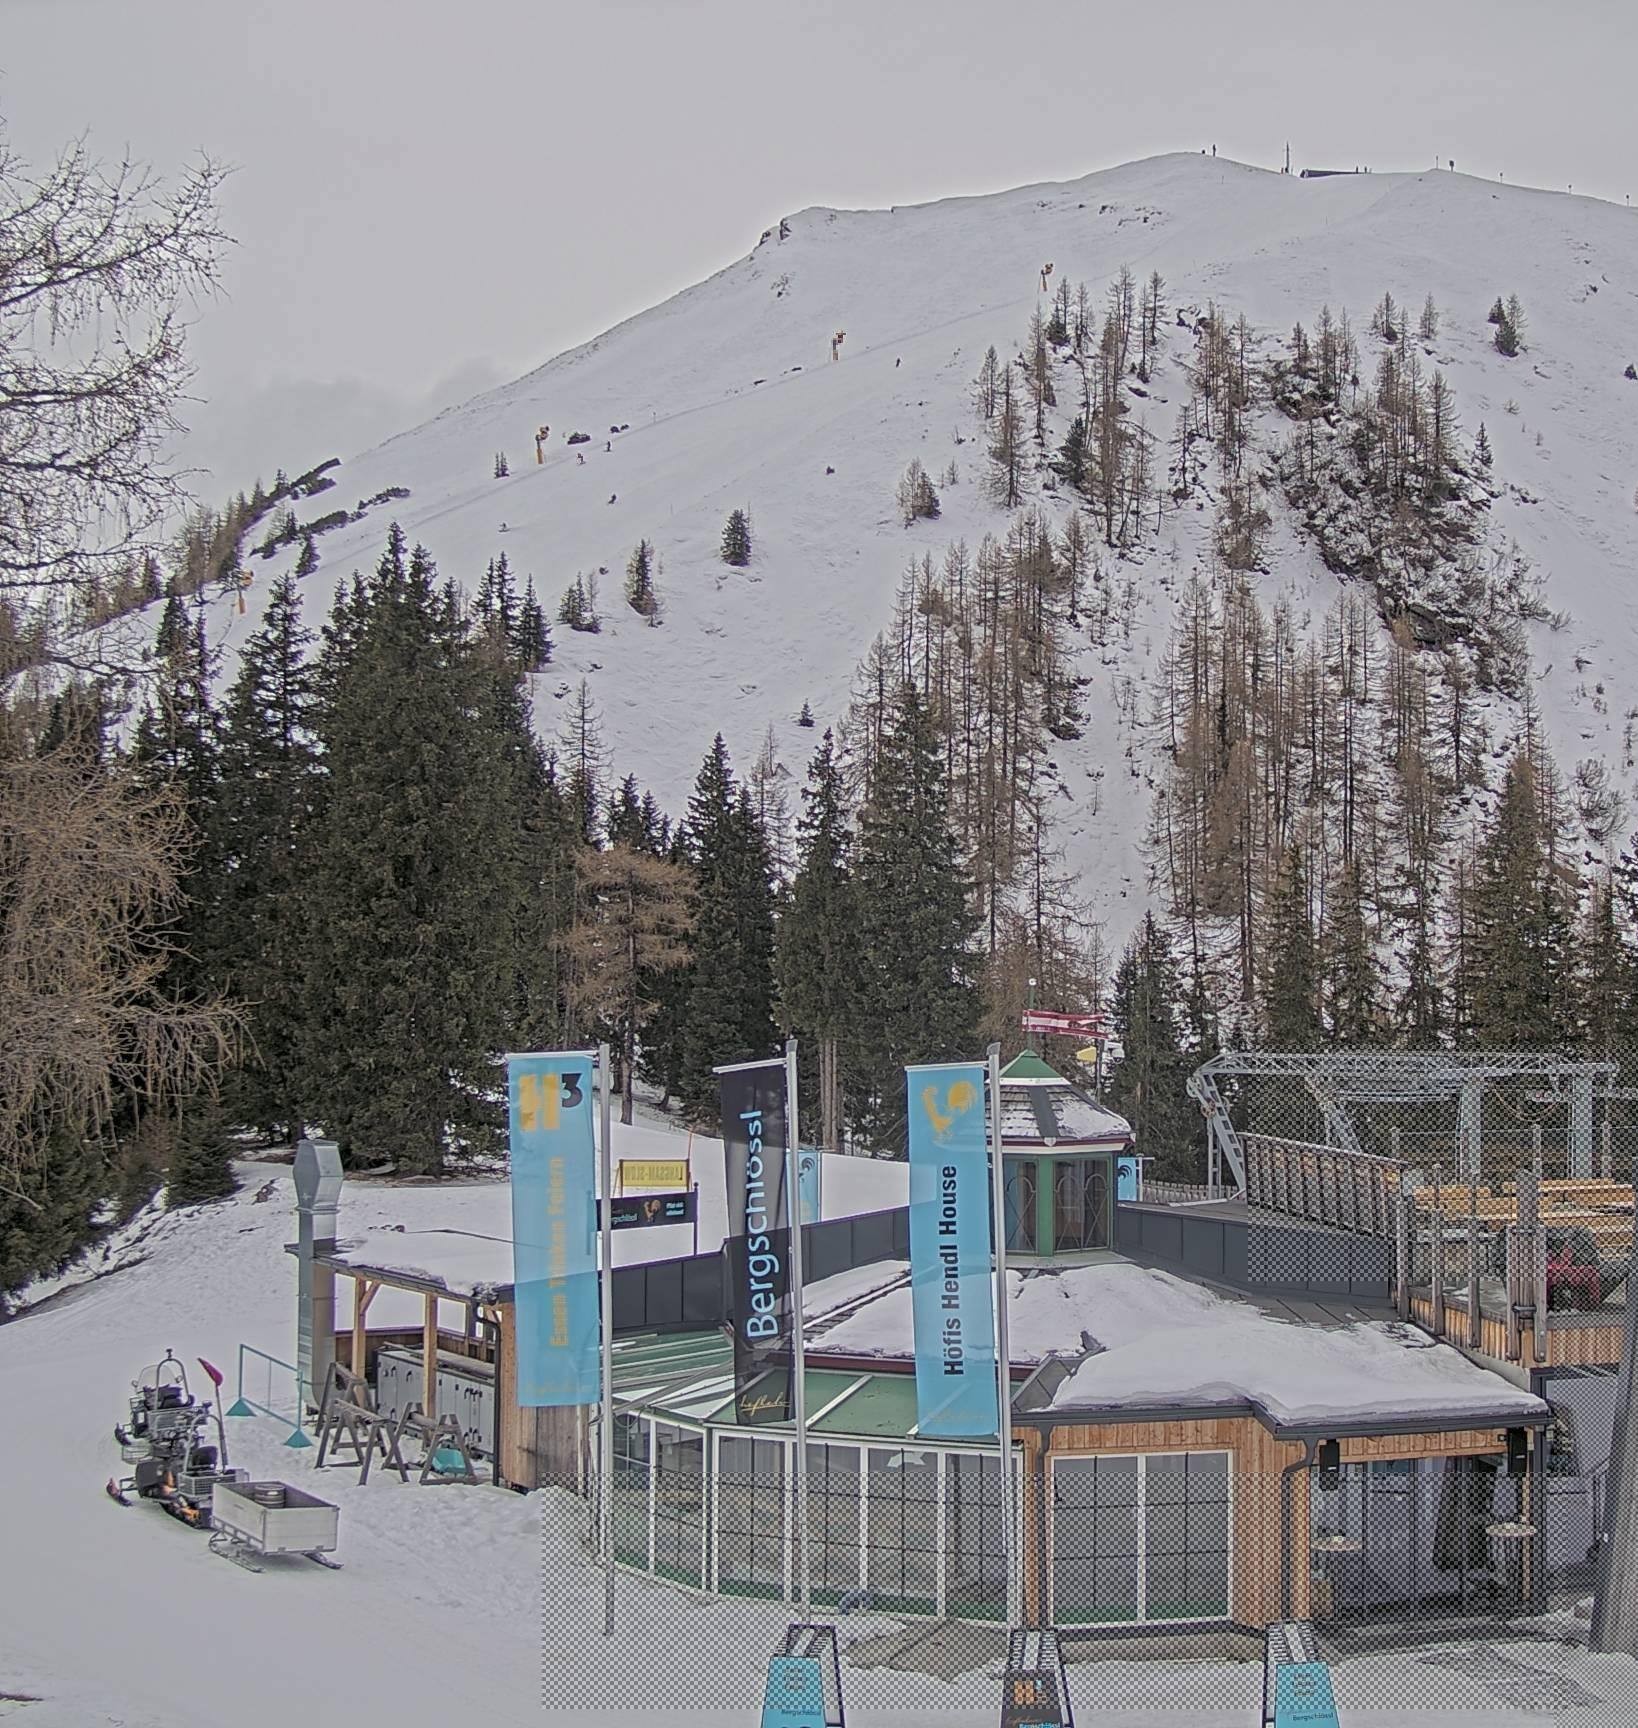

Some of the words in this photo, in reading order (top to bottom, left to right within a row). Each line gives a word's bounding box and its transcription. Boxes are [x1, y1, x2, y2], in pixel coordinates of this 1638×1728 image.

[740, 1110, 779, 1338] Bergschlössl
[939, 1166, 957, 1235] House
[941, 1250, 960, 1309] Hendl
[943, 1318, 964, 1375] Höfis
